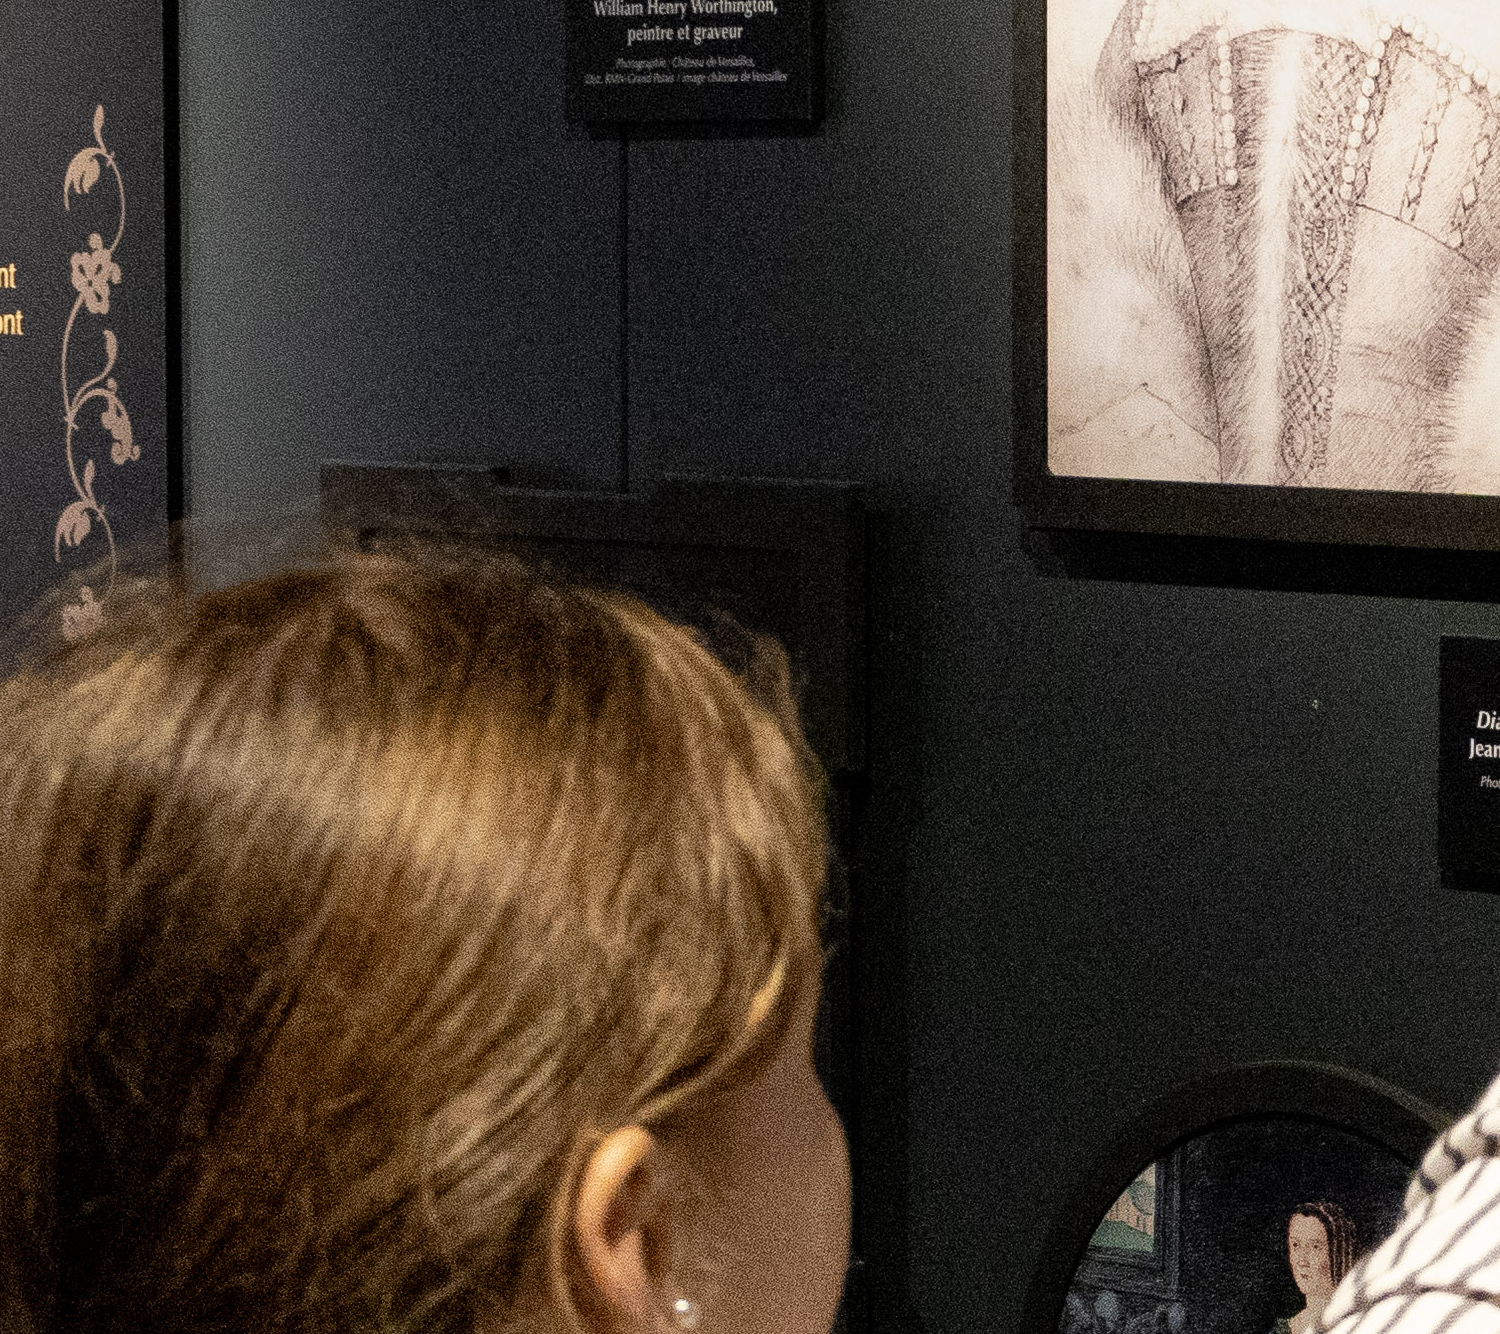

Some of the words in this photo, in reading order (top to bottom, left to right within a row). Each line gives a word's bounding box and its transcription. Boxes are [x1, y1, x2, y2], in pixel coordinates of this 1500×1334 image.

[594, 0, 643, 16] William
[647, 0, 687, 19] Henry
[628, 24, 673, 46] peintre
[678, 25, 690, 40] et
[694, 26, 743, 45] graveur
